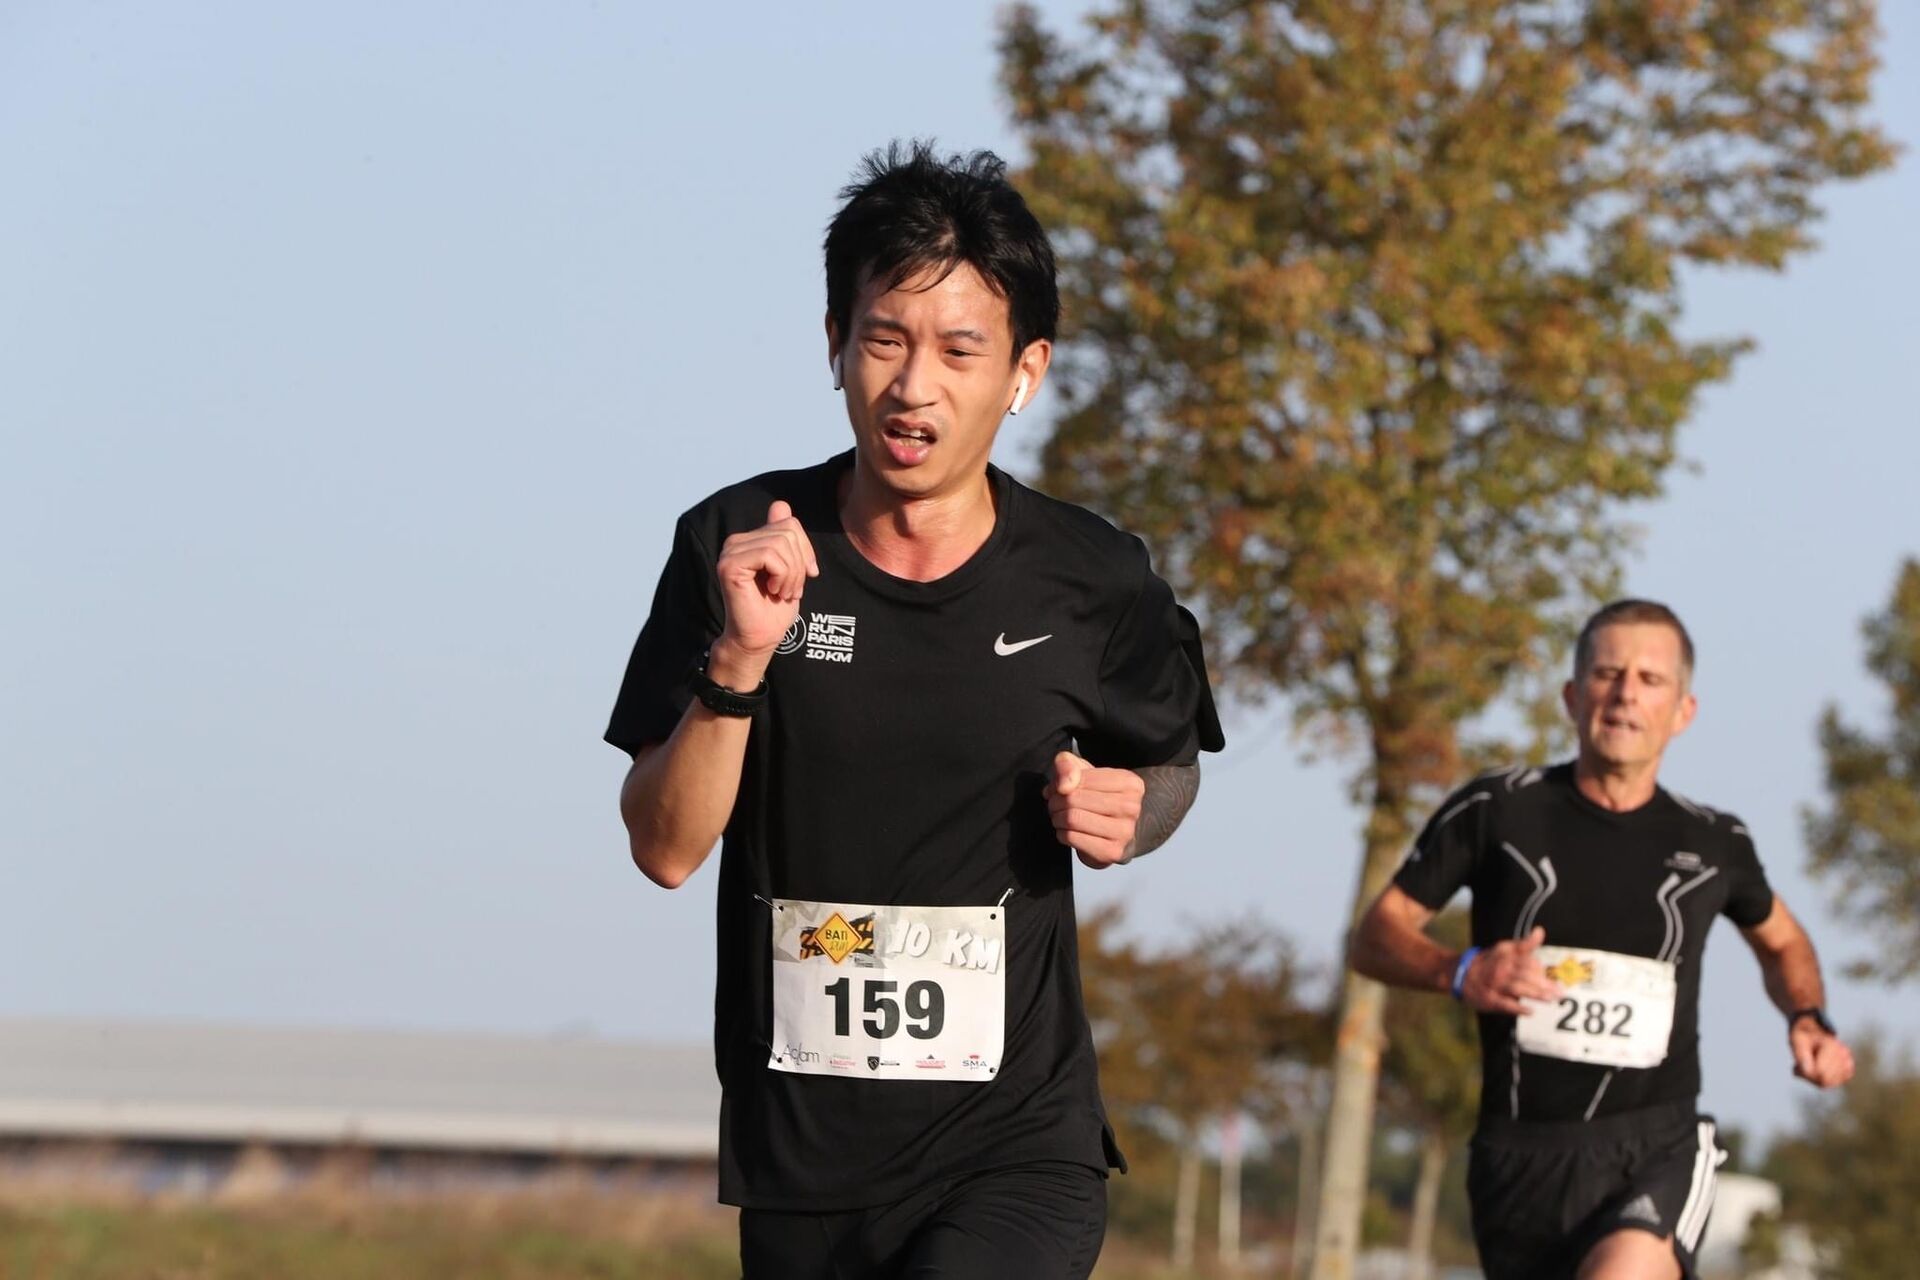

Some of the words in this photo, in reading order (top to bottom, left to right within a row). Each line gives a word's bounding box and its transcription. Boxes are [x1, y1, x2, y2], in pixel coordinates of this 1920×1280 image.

[810, 612, 856, 626] WE
[808, 622, 855, 637] RUN
[807, 632, 854, 647] PARIS
[886, 919, 932, 957] 10
[943, 929, 1000, 974] KM
[825, 977, 945, 1040] 159
[1556, 998, 1633, 1038] 282
[962, 1060, 987, 1068] SMA
